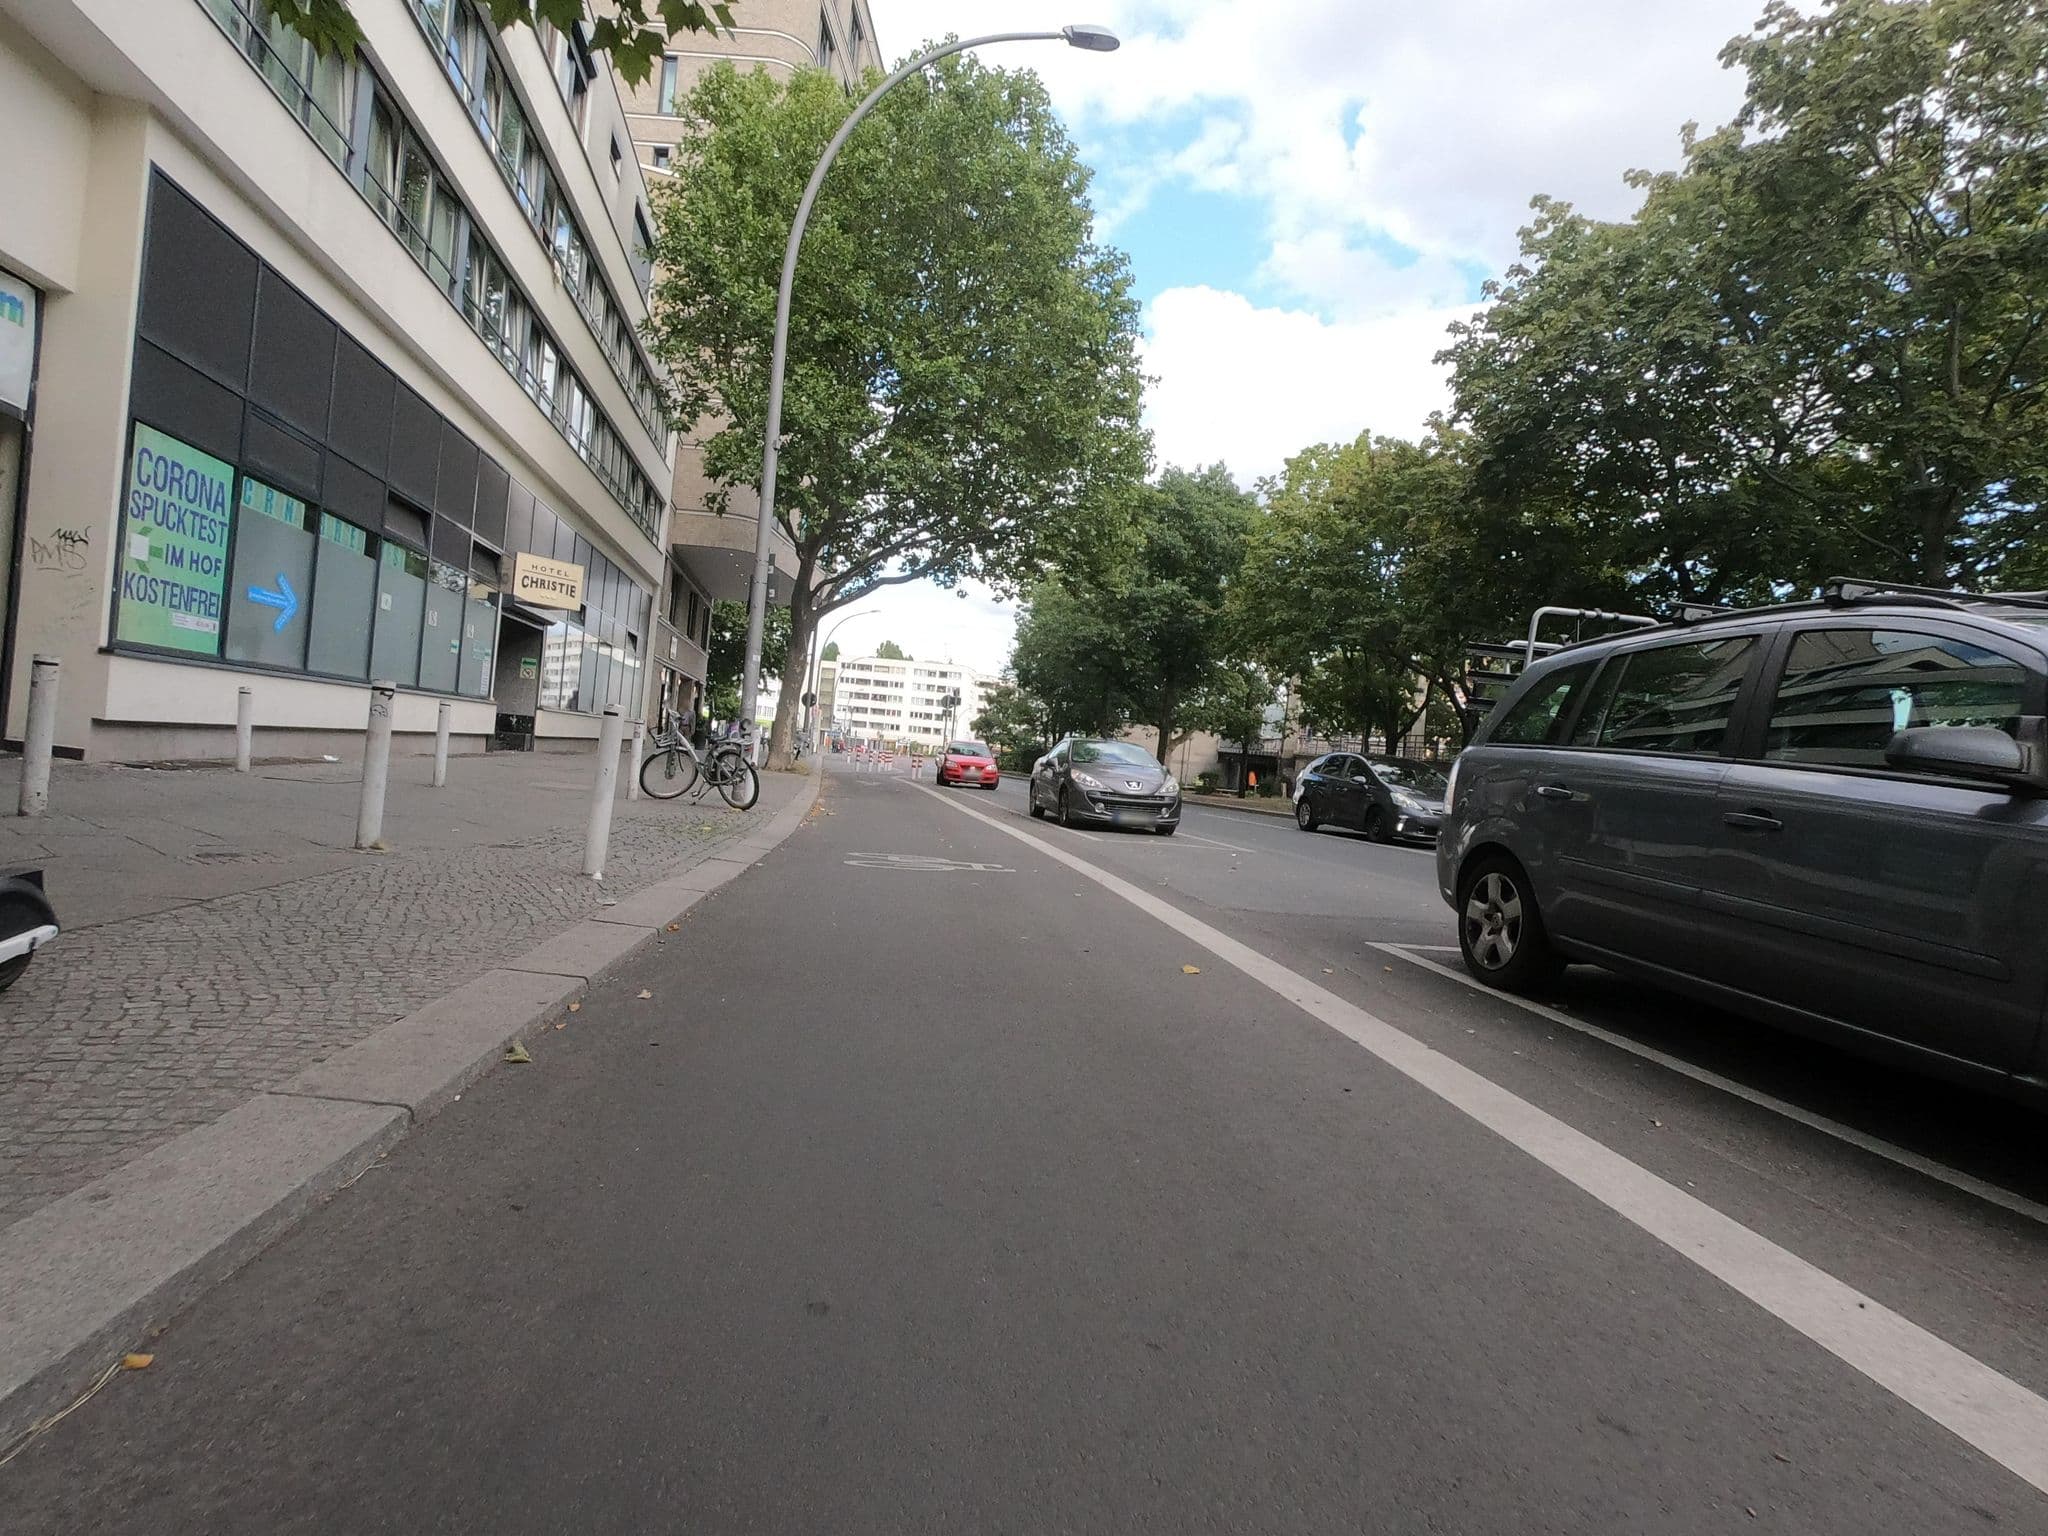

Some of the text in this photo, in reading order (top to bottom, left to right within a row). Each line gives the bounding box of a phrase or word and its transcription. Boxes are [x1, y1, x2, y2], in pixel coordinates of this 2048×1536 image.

[137, 447, 226, 518] CORONA
[130, 489, 228, 548] SPUCKTEST
[165, 543, 222, 577] IM HOF
[531, 564, 569, 577] HOTEL
[123, 570, 220, 618] KOSTENFREI
[521, 575, 577, 599] CHRISTIE
